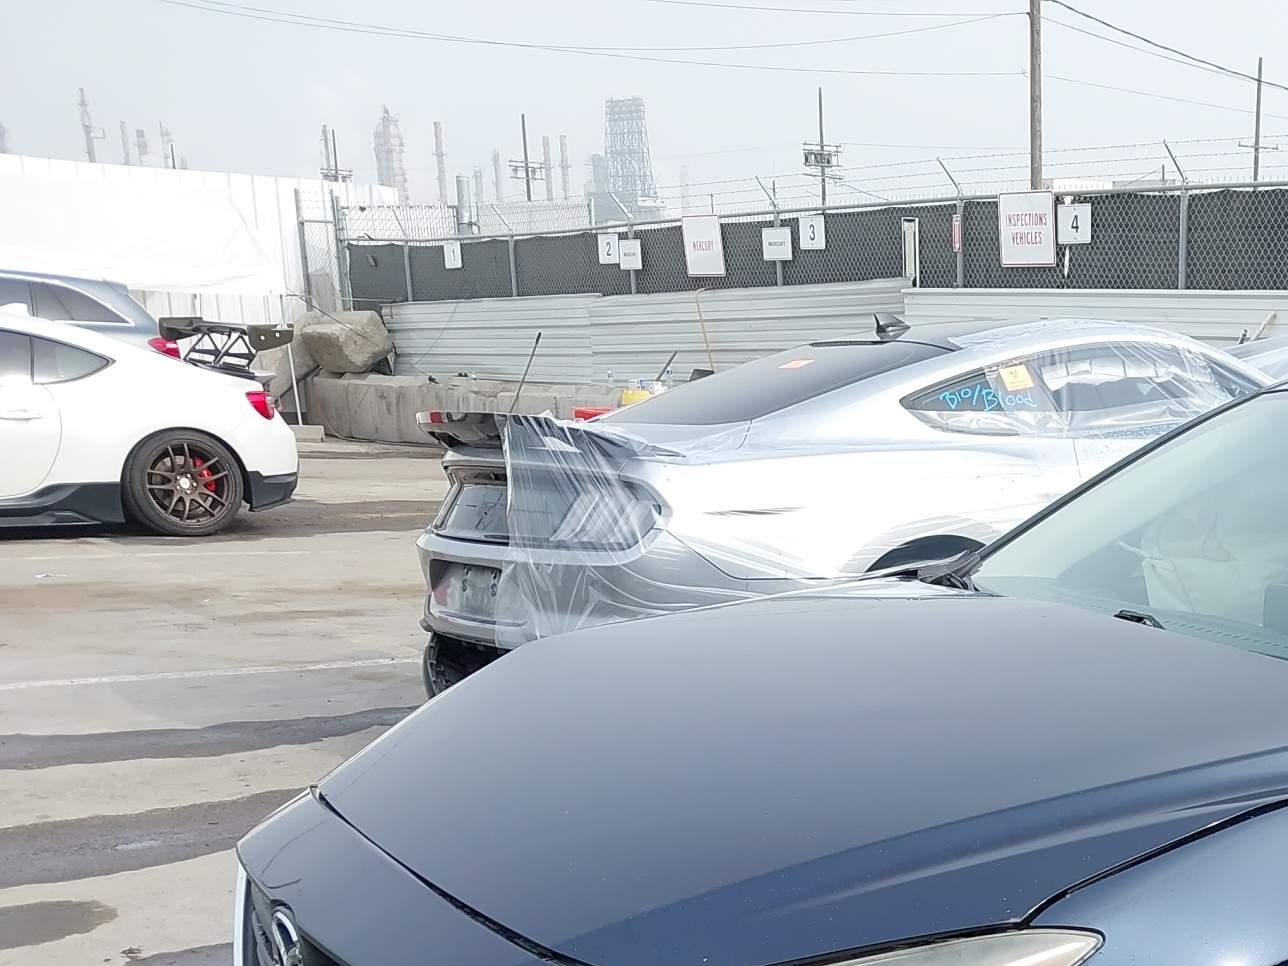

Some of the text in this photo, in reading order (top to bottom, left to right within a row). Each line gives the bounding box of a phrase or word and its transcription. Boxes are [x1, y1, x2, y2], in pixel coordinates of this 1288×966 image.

[1005, 213, 1048, 227] INSPECTIONS
[1071, 214, 1080, 233] 4
[809, 224, 816, 241] 3
[1011, 231, 1043, 245] VEHICLES
[605, 241, 612, 256] 2
